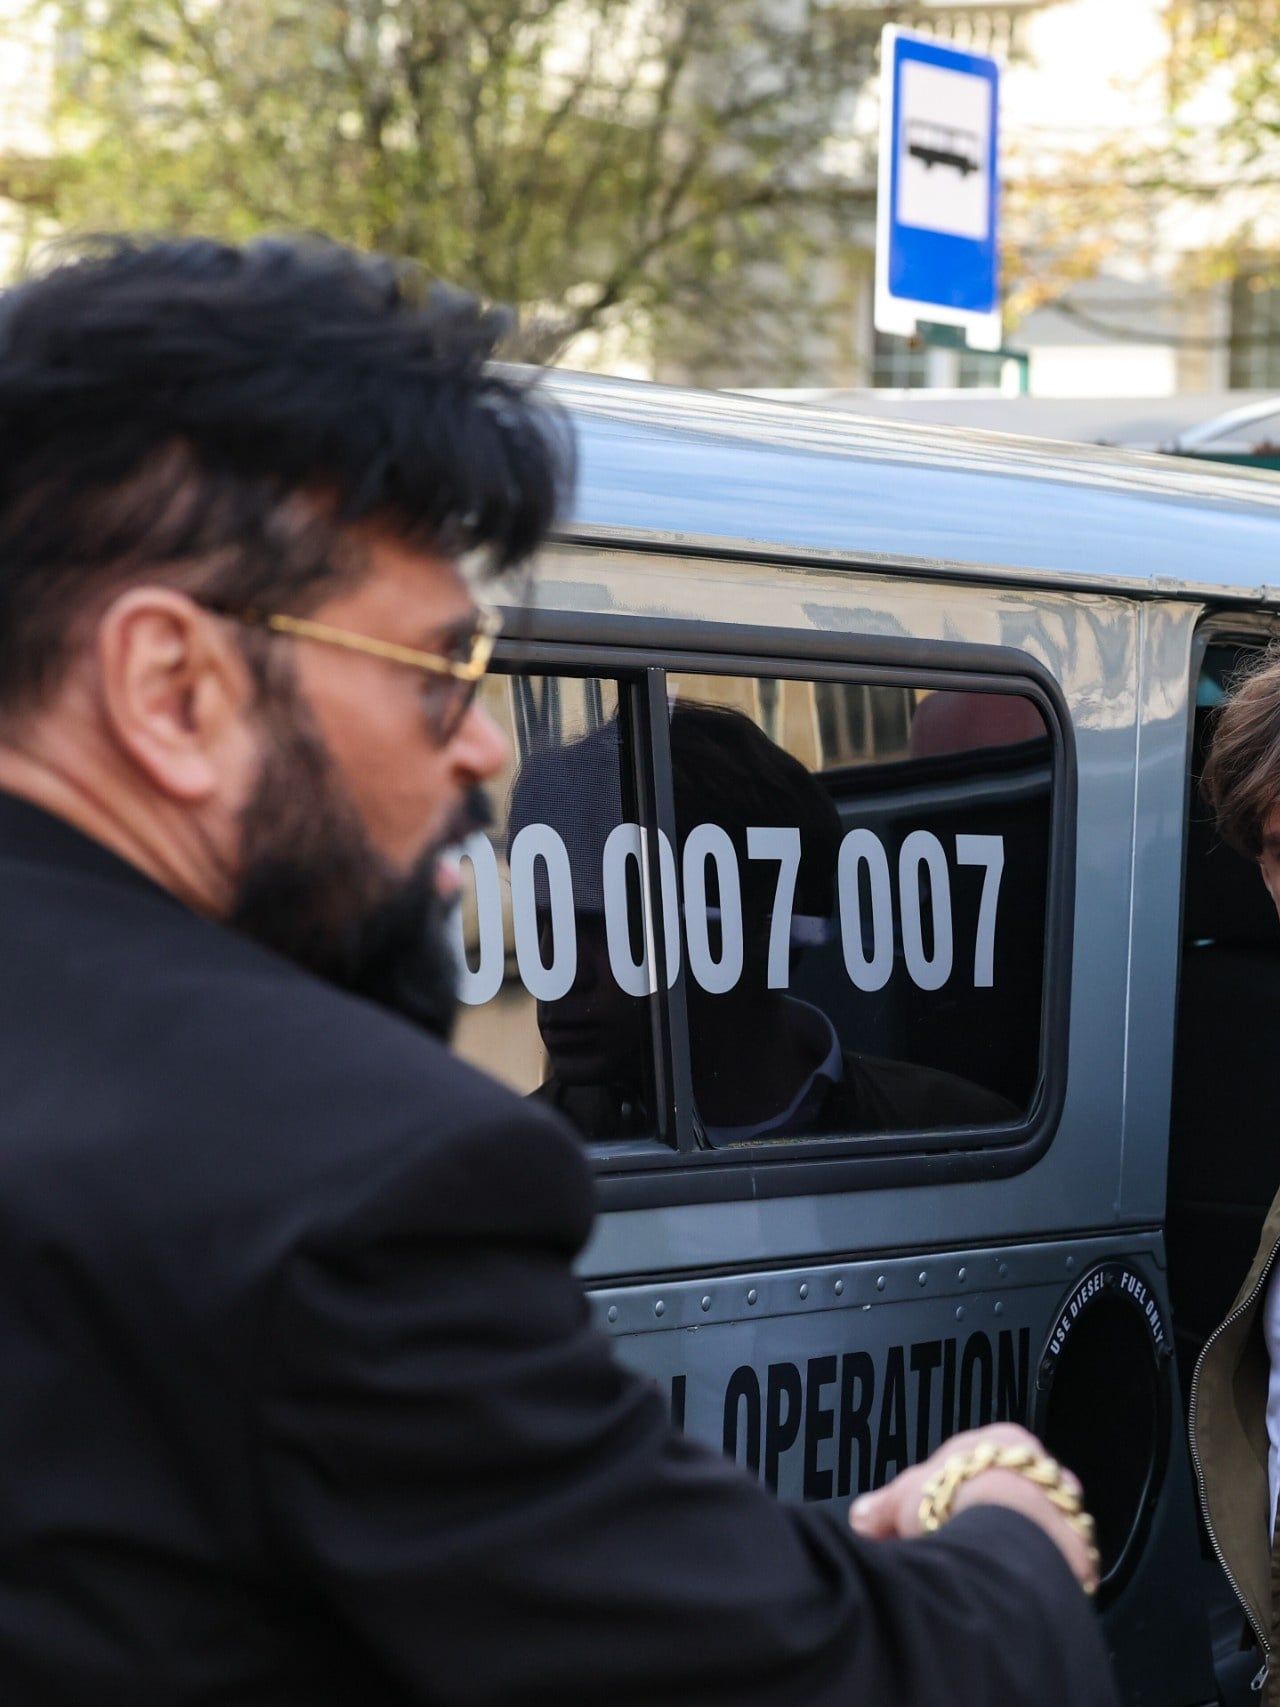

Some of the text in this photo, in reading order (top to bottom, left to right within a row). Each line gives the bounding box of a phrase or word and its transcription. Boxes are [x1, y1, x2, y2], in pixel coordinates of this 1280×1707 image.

[603, 823, 801, 997] 007
[838, 828, 1005, 992] 007
[1050, 1316, 1071, 1355] USE
[1120, 1271, 1146, 1305] FUEL
[1145, 1300, 1163, 1343] ONLY
[723, 1327, 1030, 1500] OPERATION
